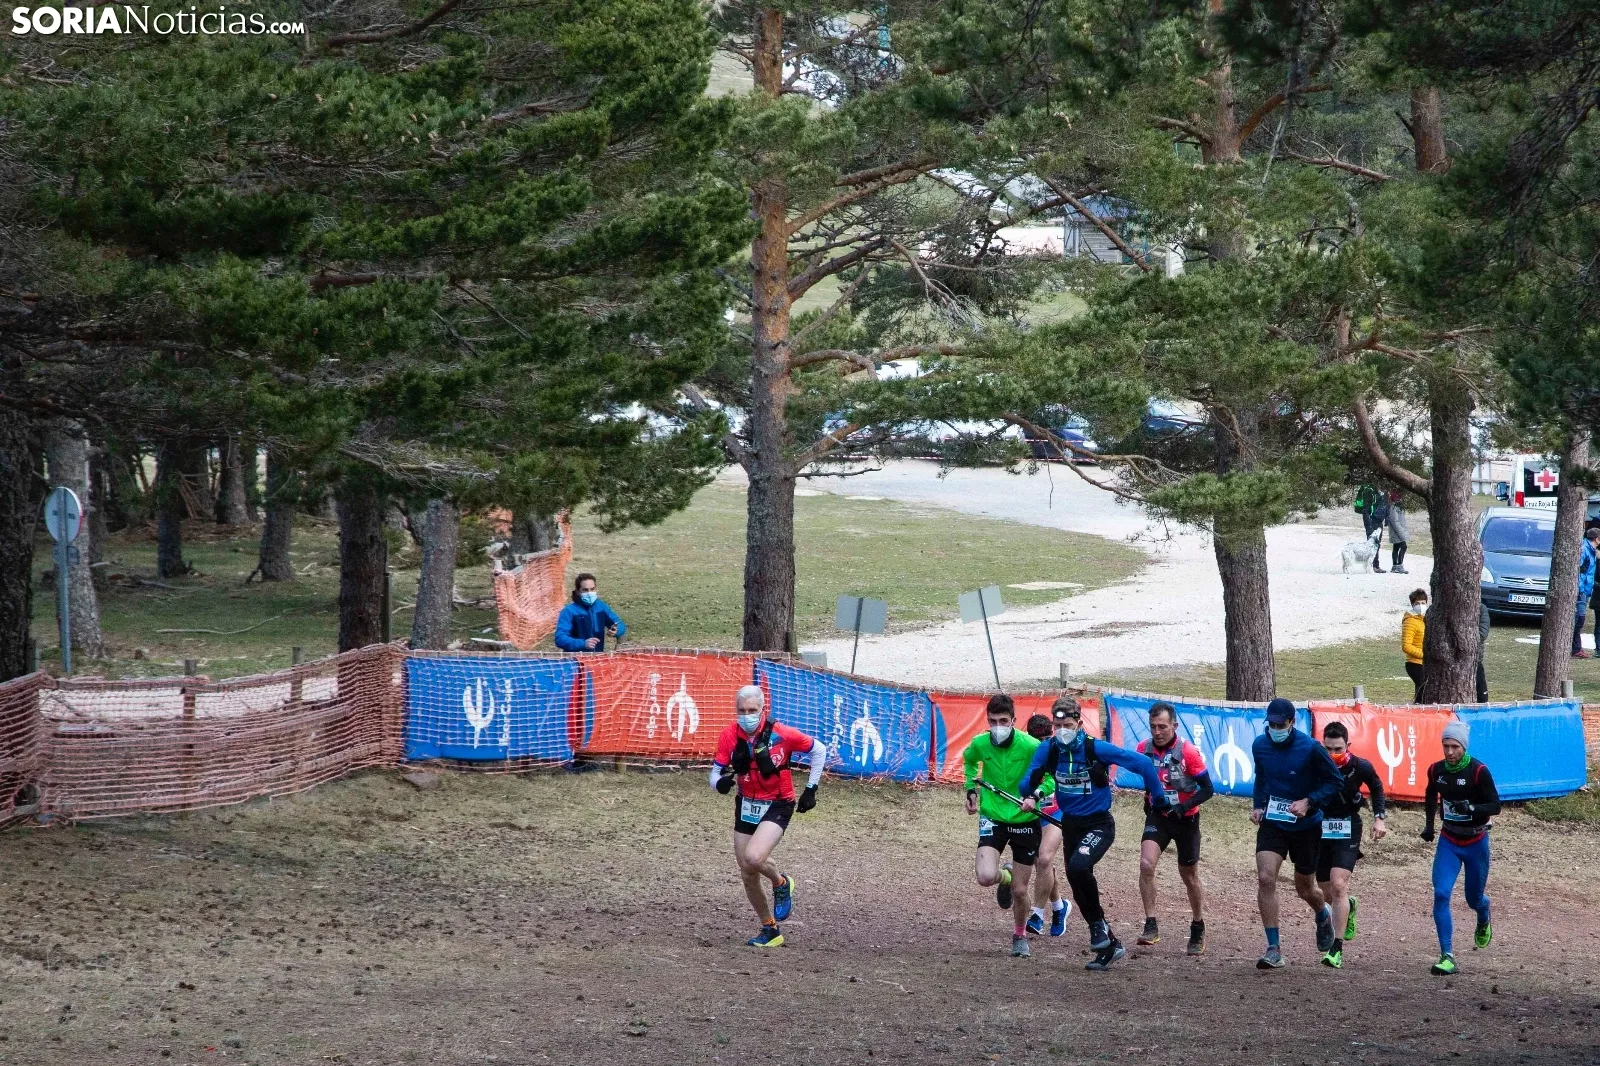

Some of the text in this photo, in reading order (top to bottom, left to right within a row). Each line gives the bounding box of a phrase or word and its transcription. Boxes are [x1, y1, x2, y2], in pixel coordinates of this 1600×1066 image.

[1538, 500, 1550, 508] Roja
[1407, 725, 1416, 786] iberCaja
[1328, 822, 1343, 830] 048
